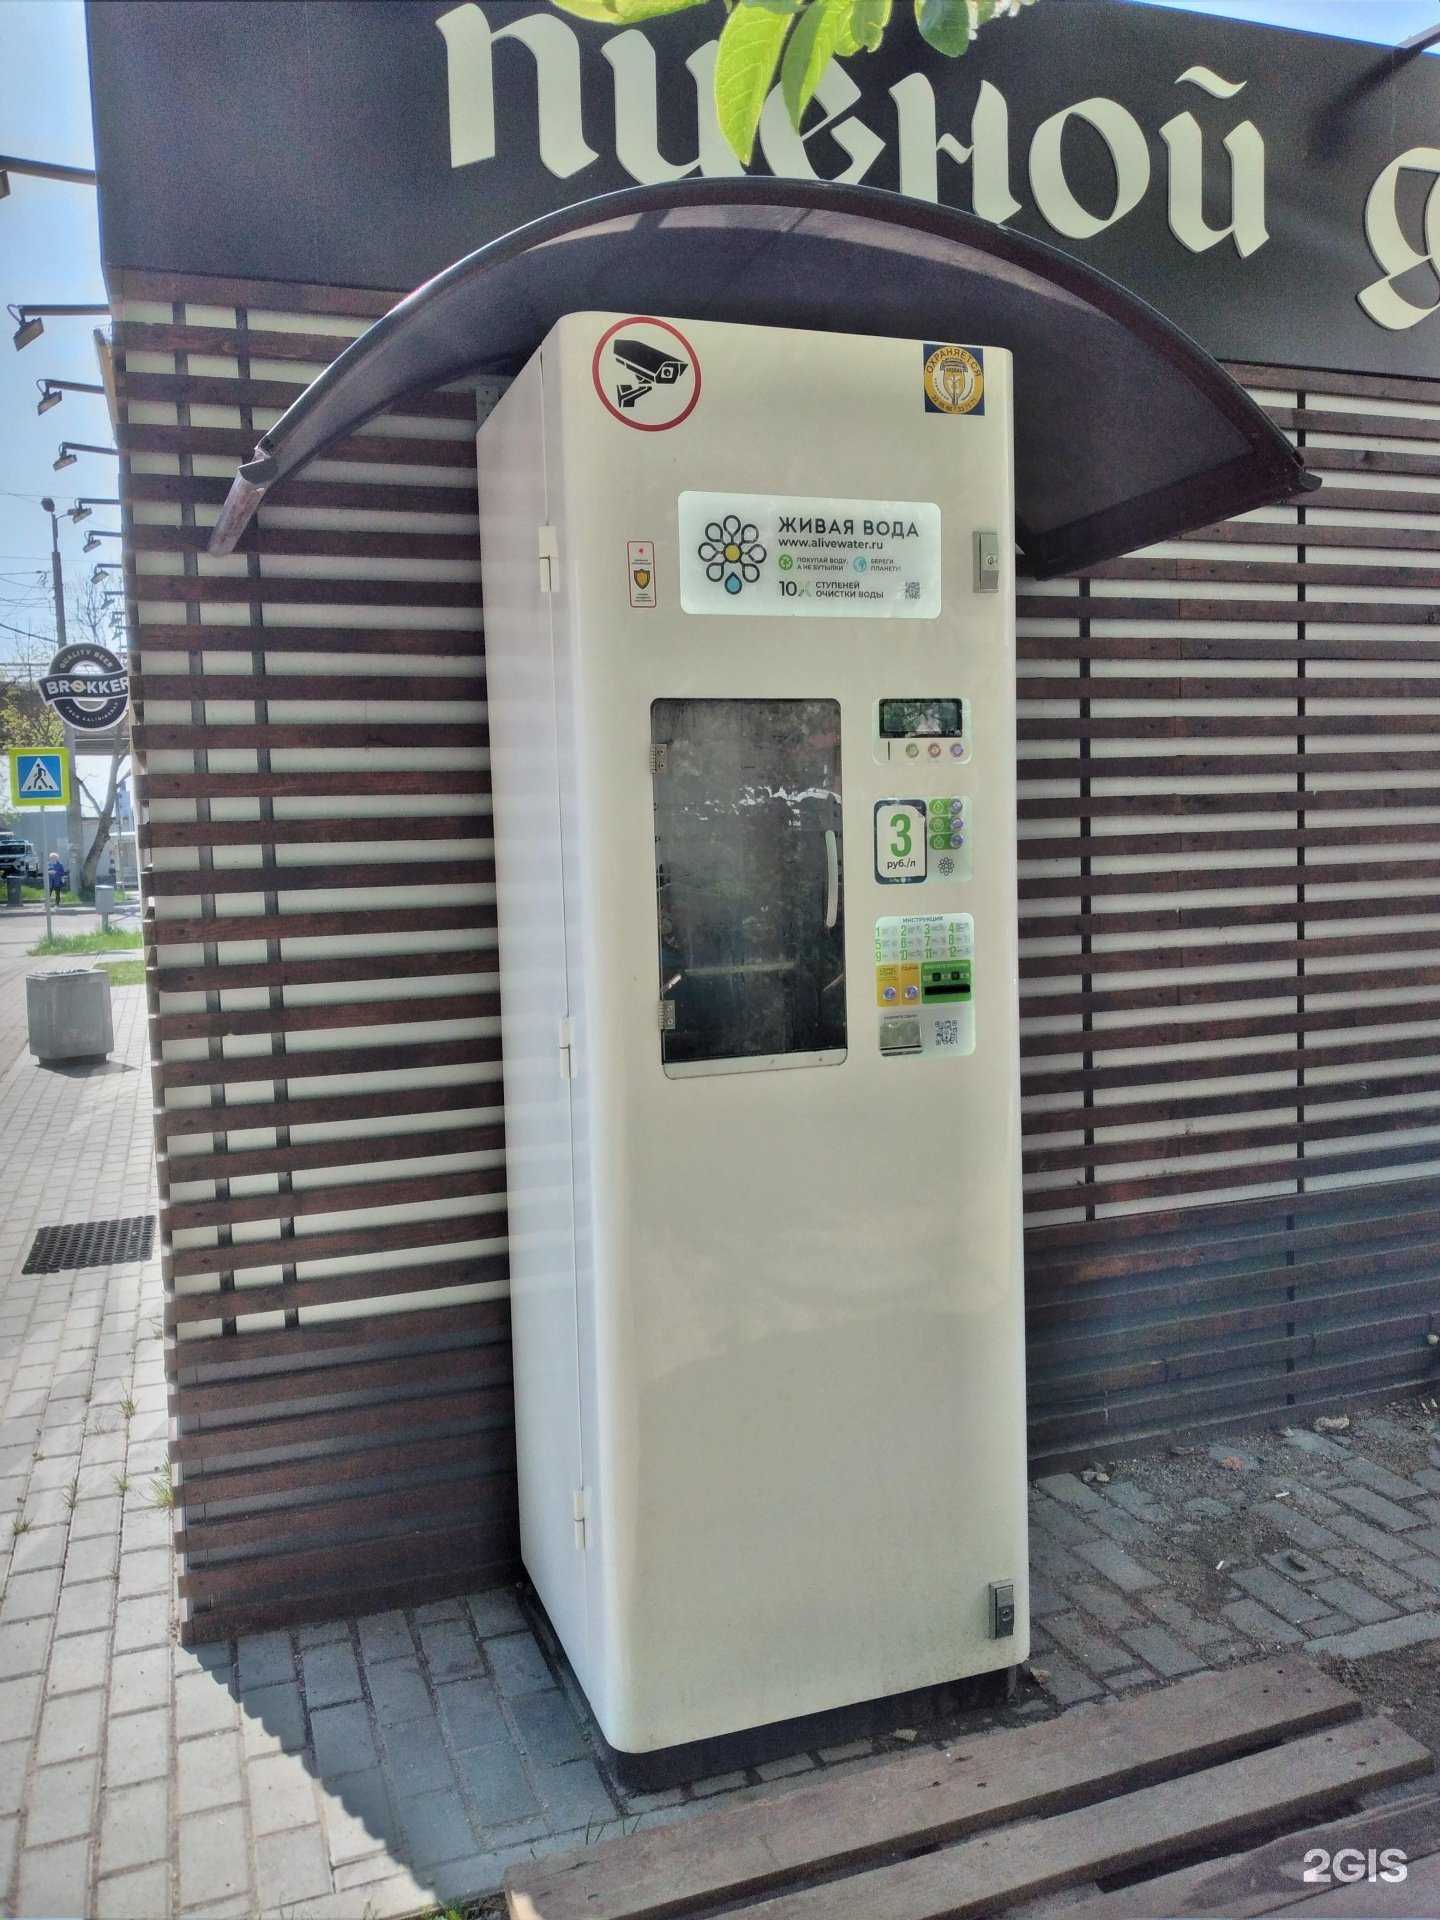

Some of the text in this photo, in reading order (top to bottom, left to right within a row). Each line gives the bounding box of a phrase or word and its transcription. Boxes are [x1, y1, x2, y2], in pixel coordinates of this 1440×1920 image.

[778, 516, 920, 540] ЖИВАЯ ВОДА
[778, 536, 884, 551] www.alivewater.ru
[796, 556, 828, 564] ПОКУПАЙ
[778, 580, 798, 597] 10
[815, 581, 860, 590] СТУПЕНЕЙ
[815, 590, 884, 599] ОЧИСТКИ ВОДЫ
[890, 813, 912, 858] 3
